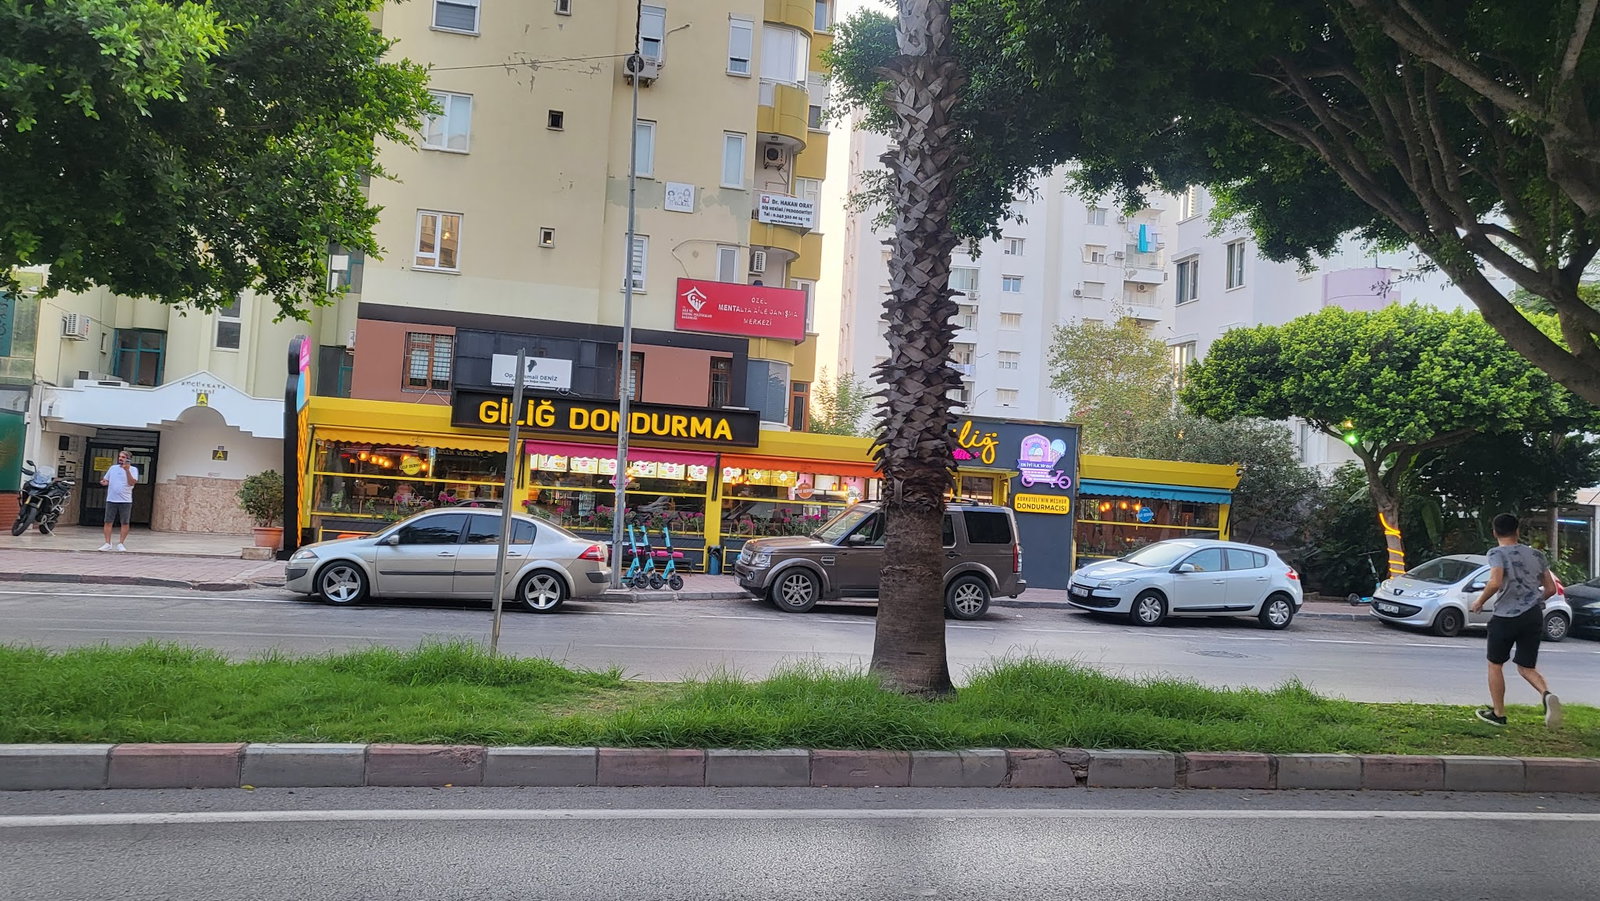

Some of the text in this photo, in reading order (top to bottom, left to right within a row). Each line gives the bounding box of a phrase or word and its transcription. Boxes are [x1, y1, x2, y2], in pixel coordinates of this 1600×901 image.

[540, 374, 558, 382] DENİZ
[197, 393, 208, 403] A
[569, 407, 733, 440] DONDURMA
[216, 450, 224, 458] A
[1017, 502, 1067, 512] DONDURMACISI
